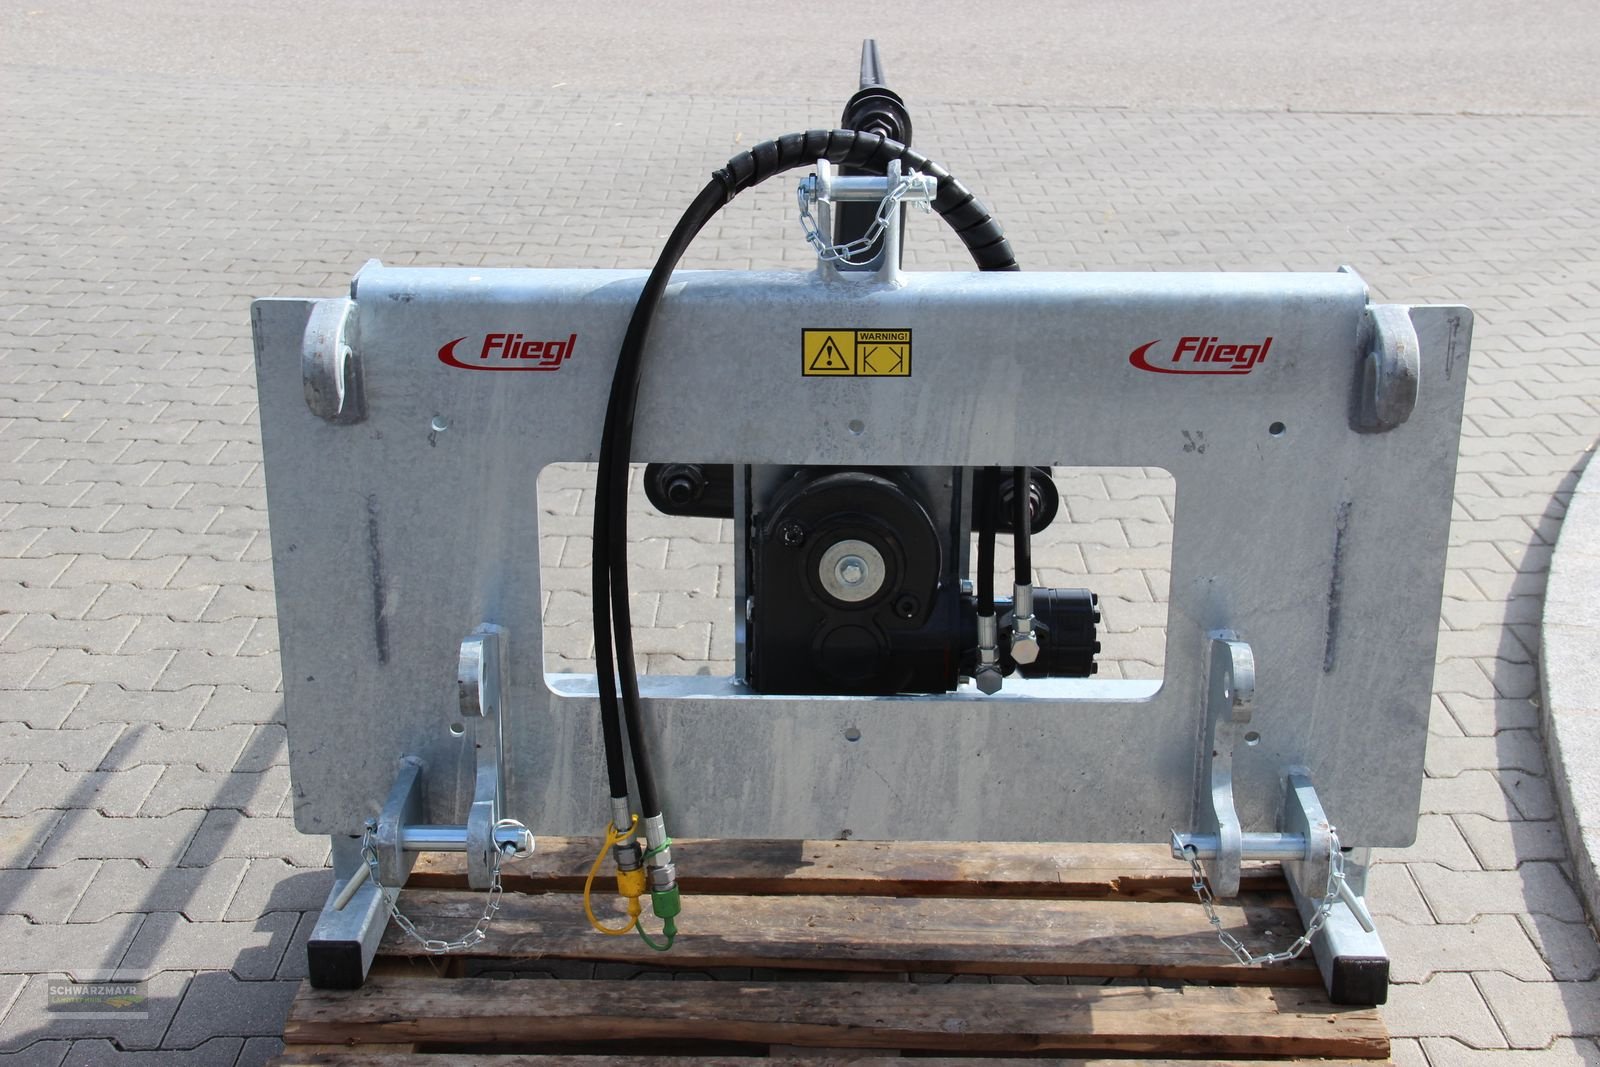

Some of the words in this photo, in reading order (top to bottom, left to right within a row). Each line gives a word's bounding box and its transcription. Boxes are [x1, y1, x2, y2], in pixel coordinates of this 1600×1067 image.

[480, 333, 577, 365] Fliegl
[860, 332, 908, 341] WARNING!
[1172, 336, 1273, 369] Fliegl
